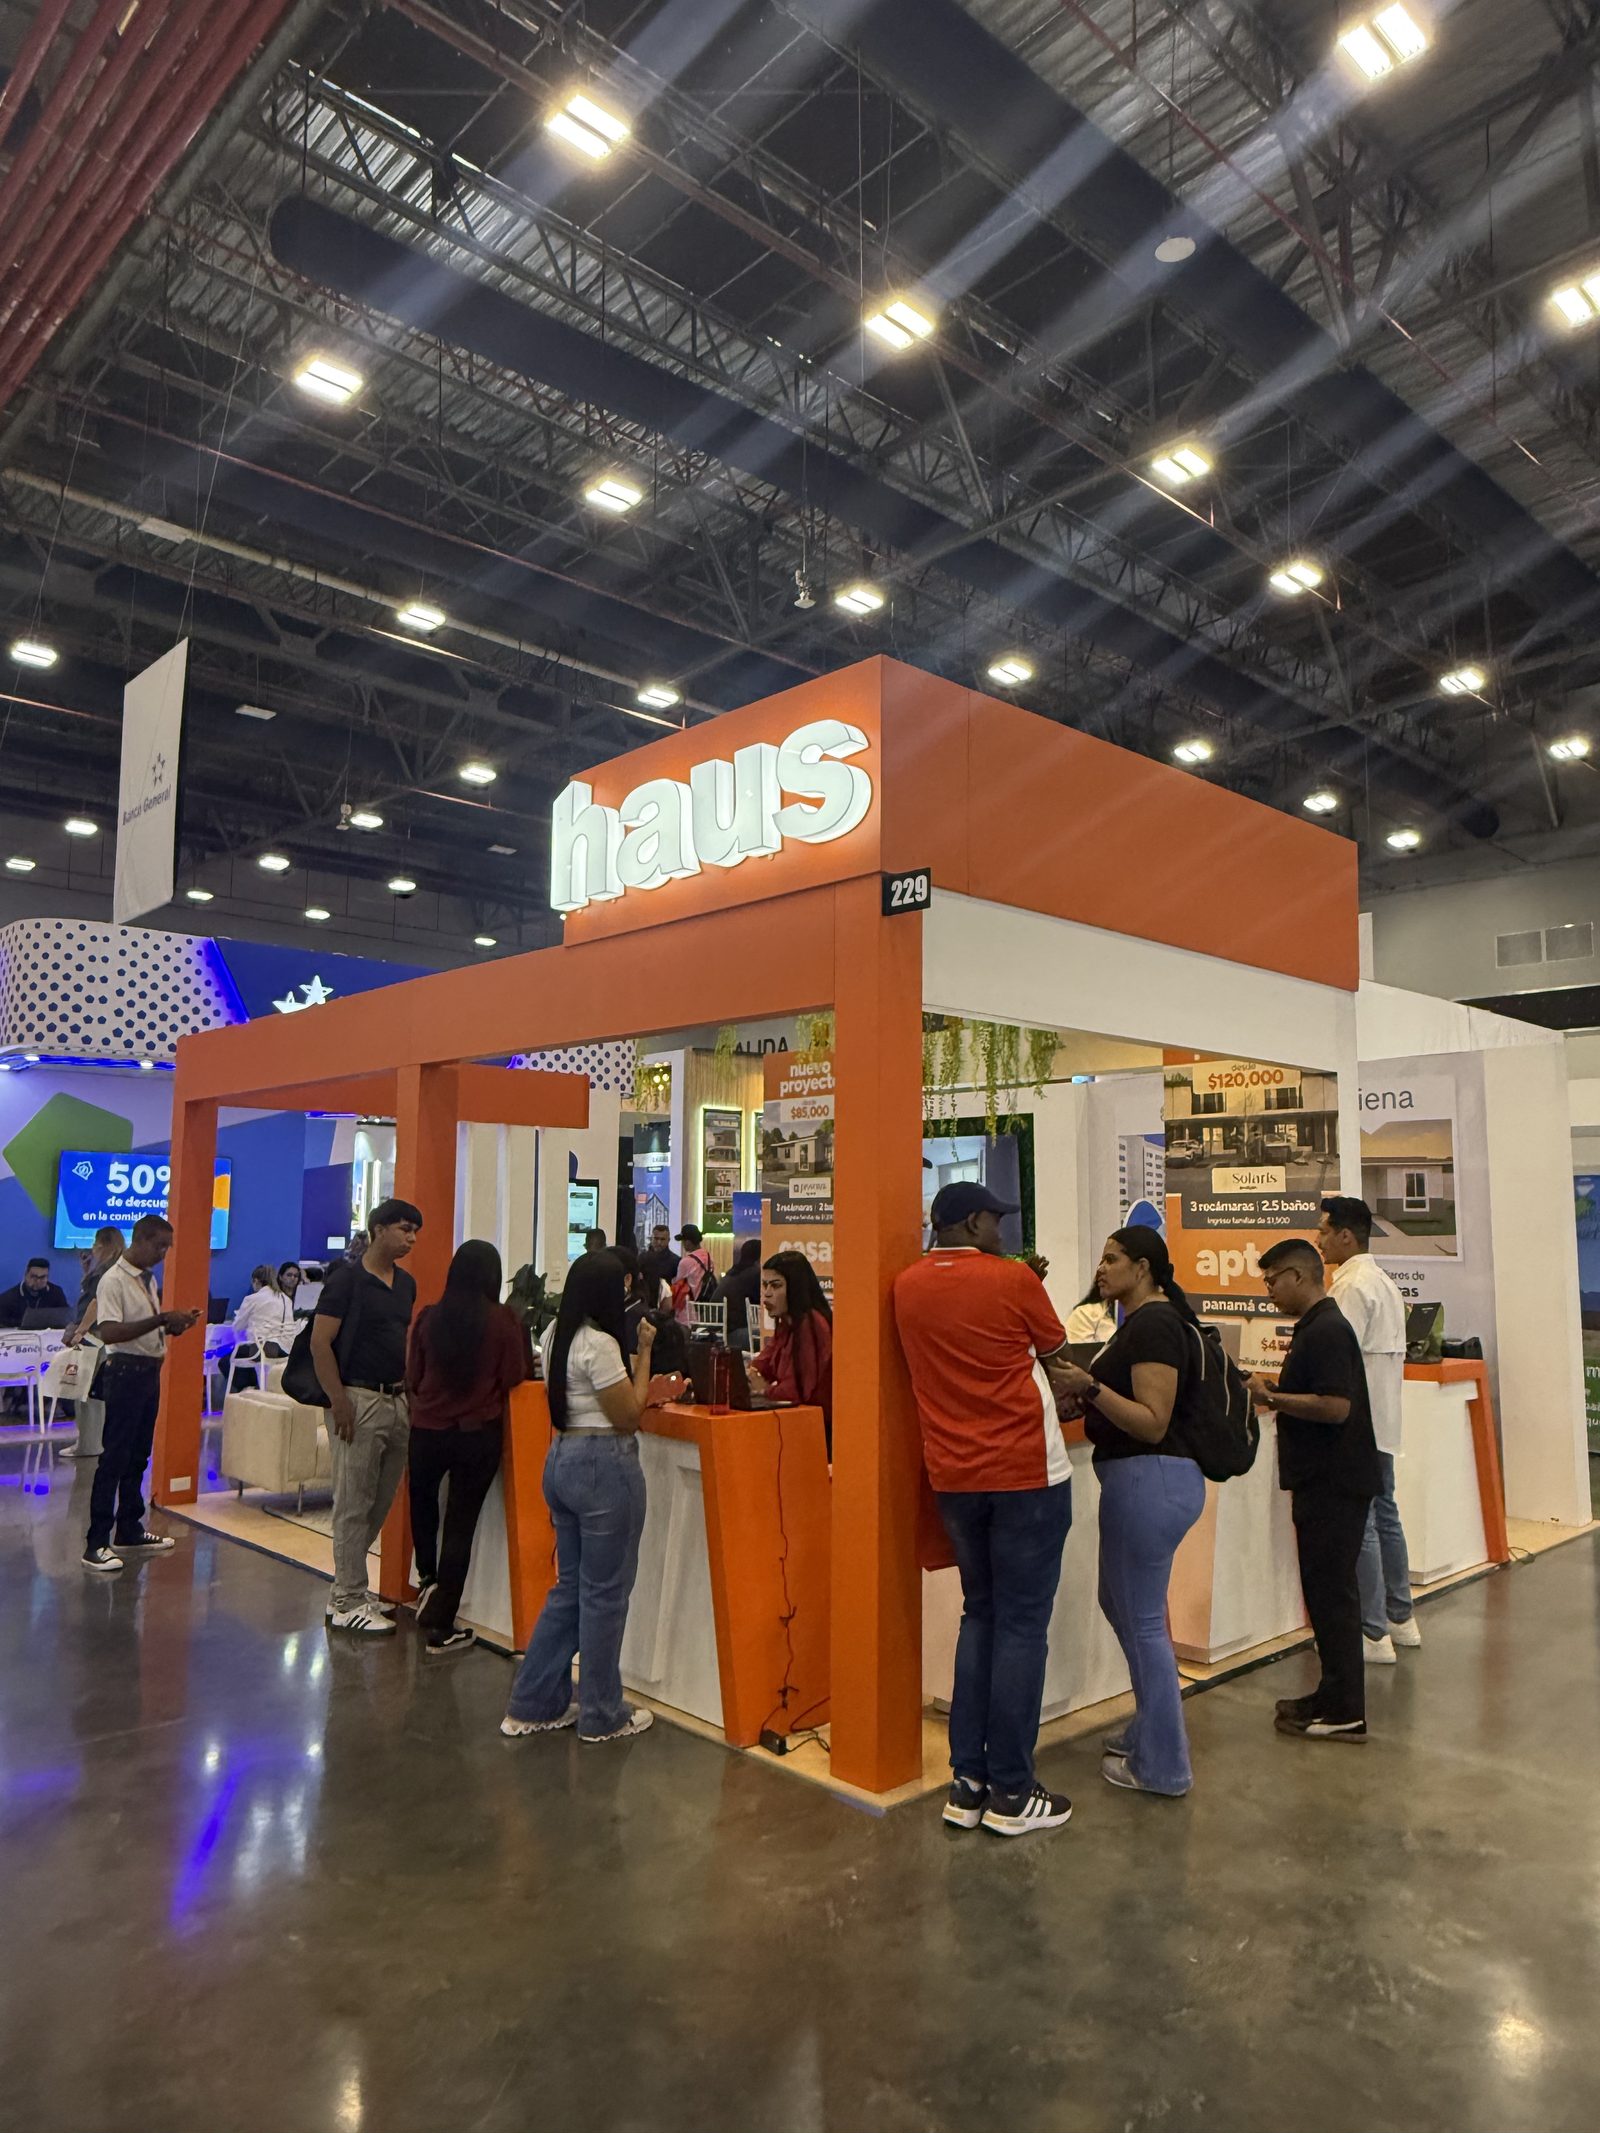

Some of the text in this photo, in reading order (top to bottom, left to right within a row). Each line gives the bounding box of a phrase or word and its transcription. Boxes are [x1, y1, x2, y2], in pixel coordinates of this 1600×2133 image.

[143, 783, 172, 813] General
[551, 719, 872, 911] haus
[891, 874, 928, 907] 229
[790, 1061, 831, 1078] nuevo
[1208, 1069, 1284, 1090] $120,000
[790, 1105, 830, 1120] $85,000
[1232, 1172, 1278, 1184] Solaris
[106, 1196, 123, 1207] de
[1190, 1201, 1197, 1211] 3
[1261, 1200, 1279, 1211] 2.5
[1281, 1200, 1316, 1211] baños
[82, 1213, 97, 1221] en
[98, 1210, 108, 1221] la
[1202, 1299, 1256, 1312] panamá
